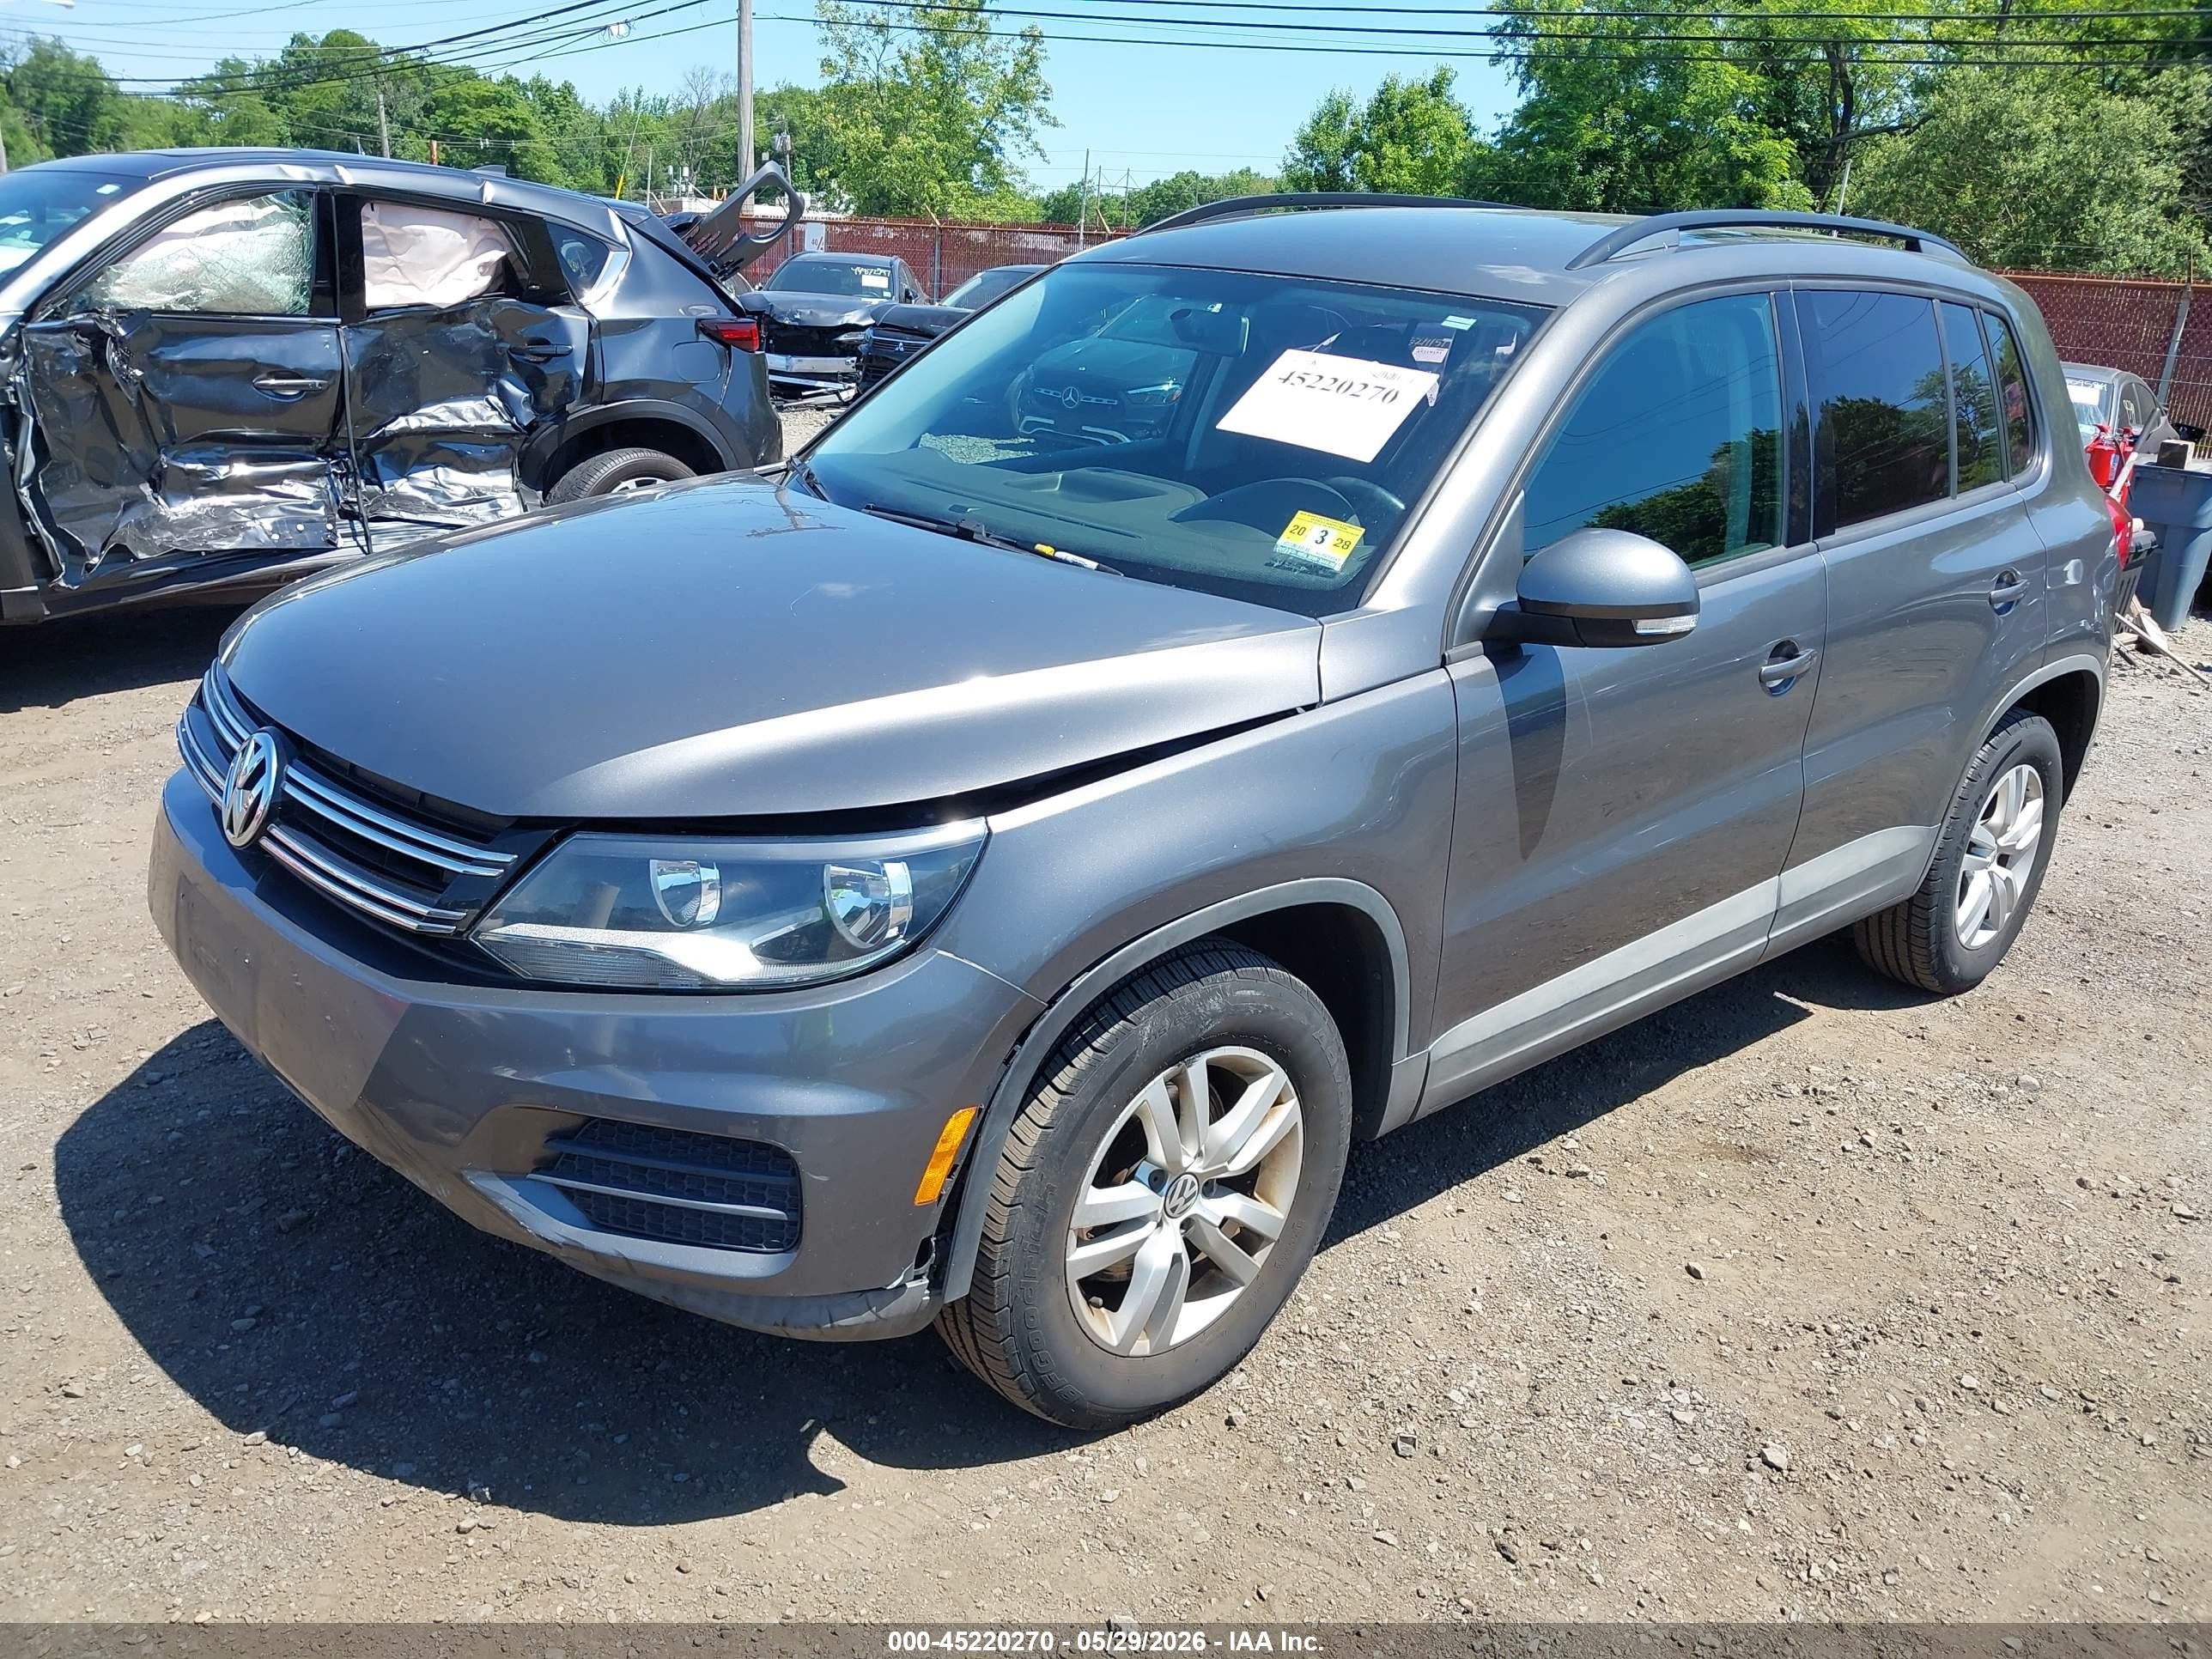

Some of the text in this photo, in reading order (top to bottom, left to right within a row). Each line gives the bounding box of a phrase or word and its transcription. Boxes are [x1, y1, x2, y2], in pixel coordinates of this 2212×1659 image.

[1278, 370, 1400, 404] 45220270
[1289, 524, 1352, 550] 20 3 28
